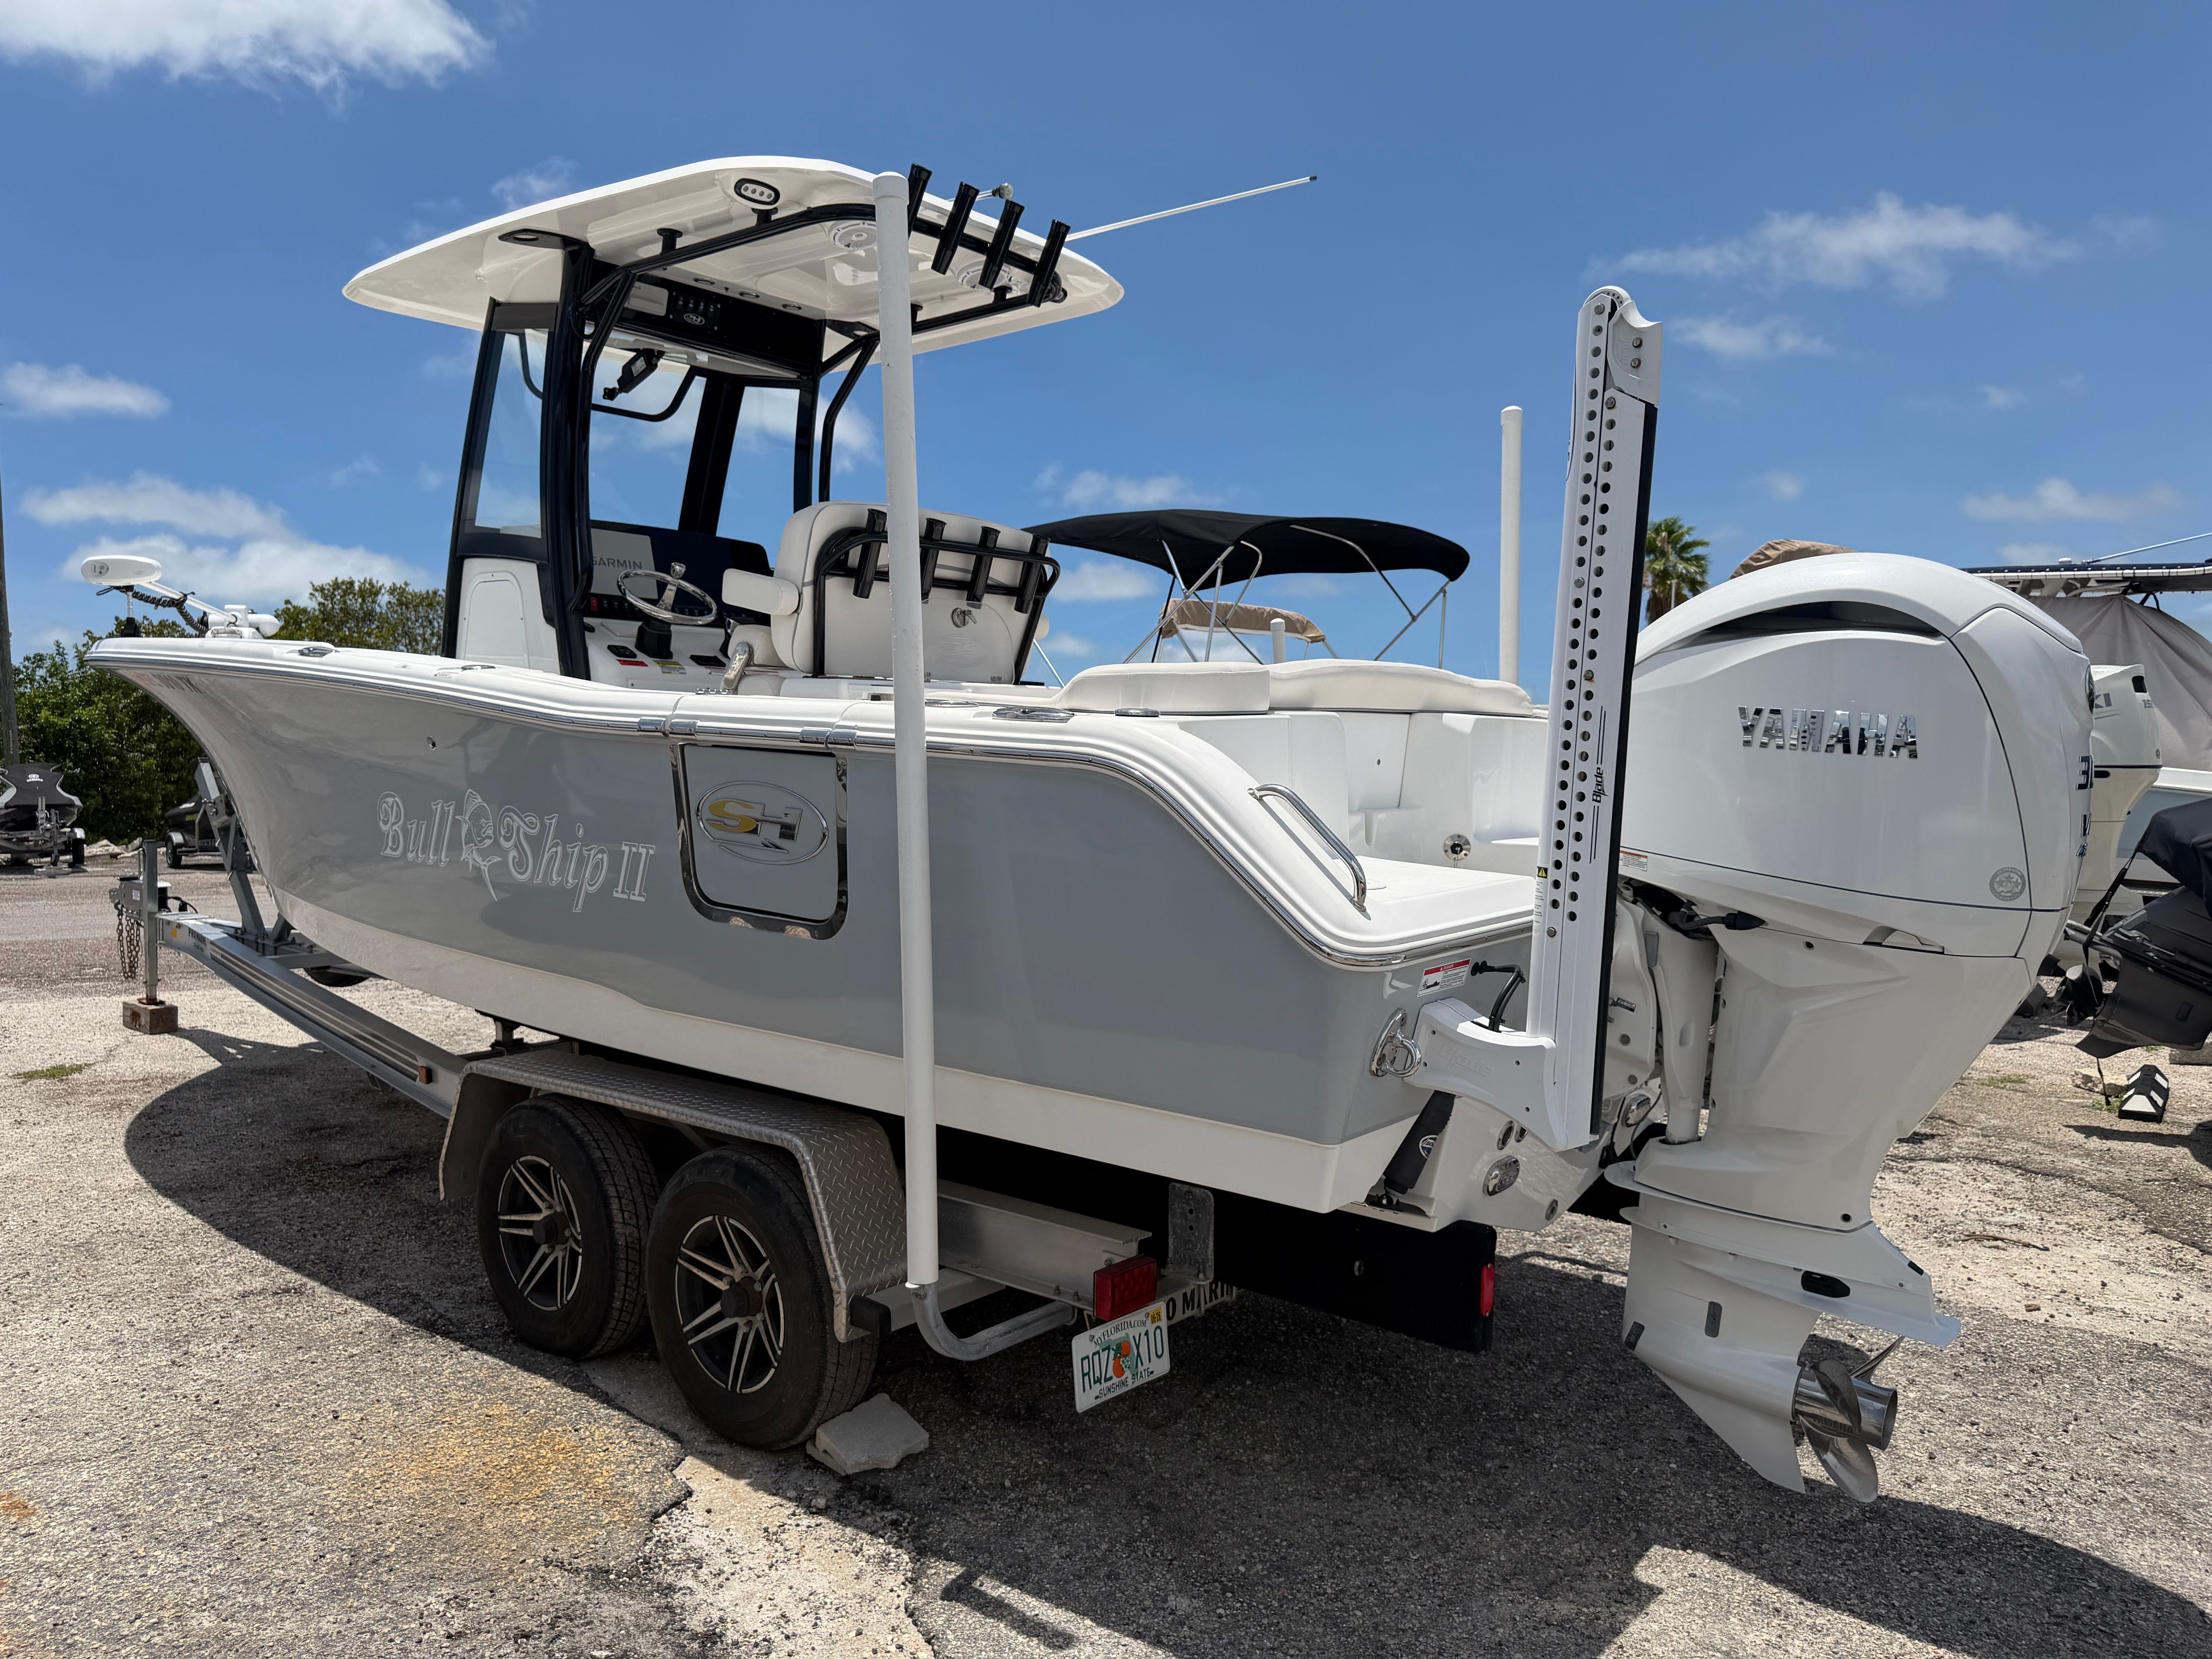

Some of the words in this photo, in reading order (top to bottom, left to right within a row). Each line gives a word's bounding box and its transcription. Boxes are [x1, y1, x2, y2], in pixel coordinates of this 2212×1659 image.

[1738, 706, 1918, 759] YAMAHA
[1592, 767, 1609, 804] Blade
[377, 791, 456, 867] Bull
[497, 805, 609, 913] Ship
[613, 841, 656, 902] II
[1080, 1345, 1113, 1393] RQZ
[1133, 1325, 1164, 1370] X10
[1099, 1376, 1129, 1399] SUNSHINE
[1132, 1367, 1151, 1384] STATE
